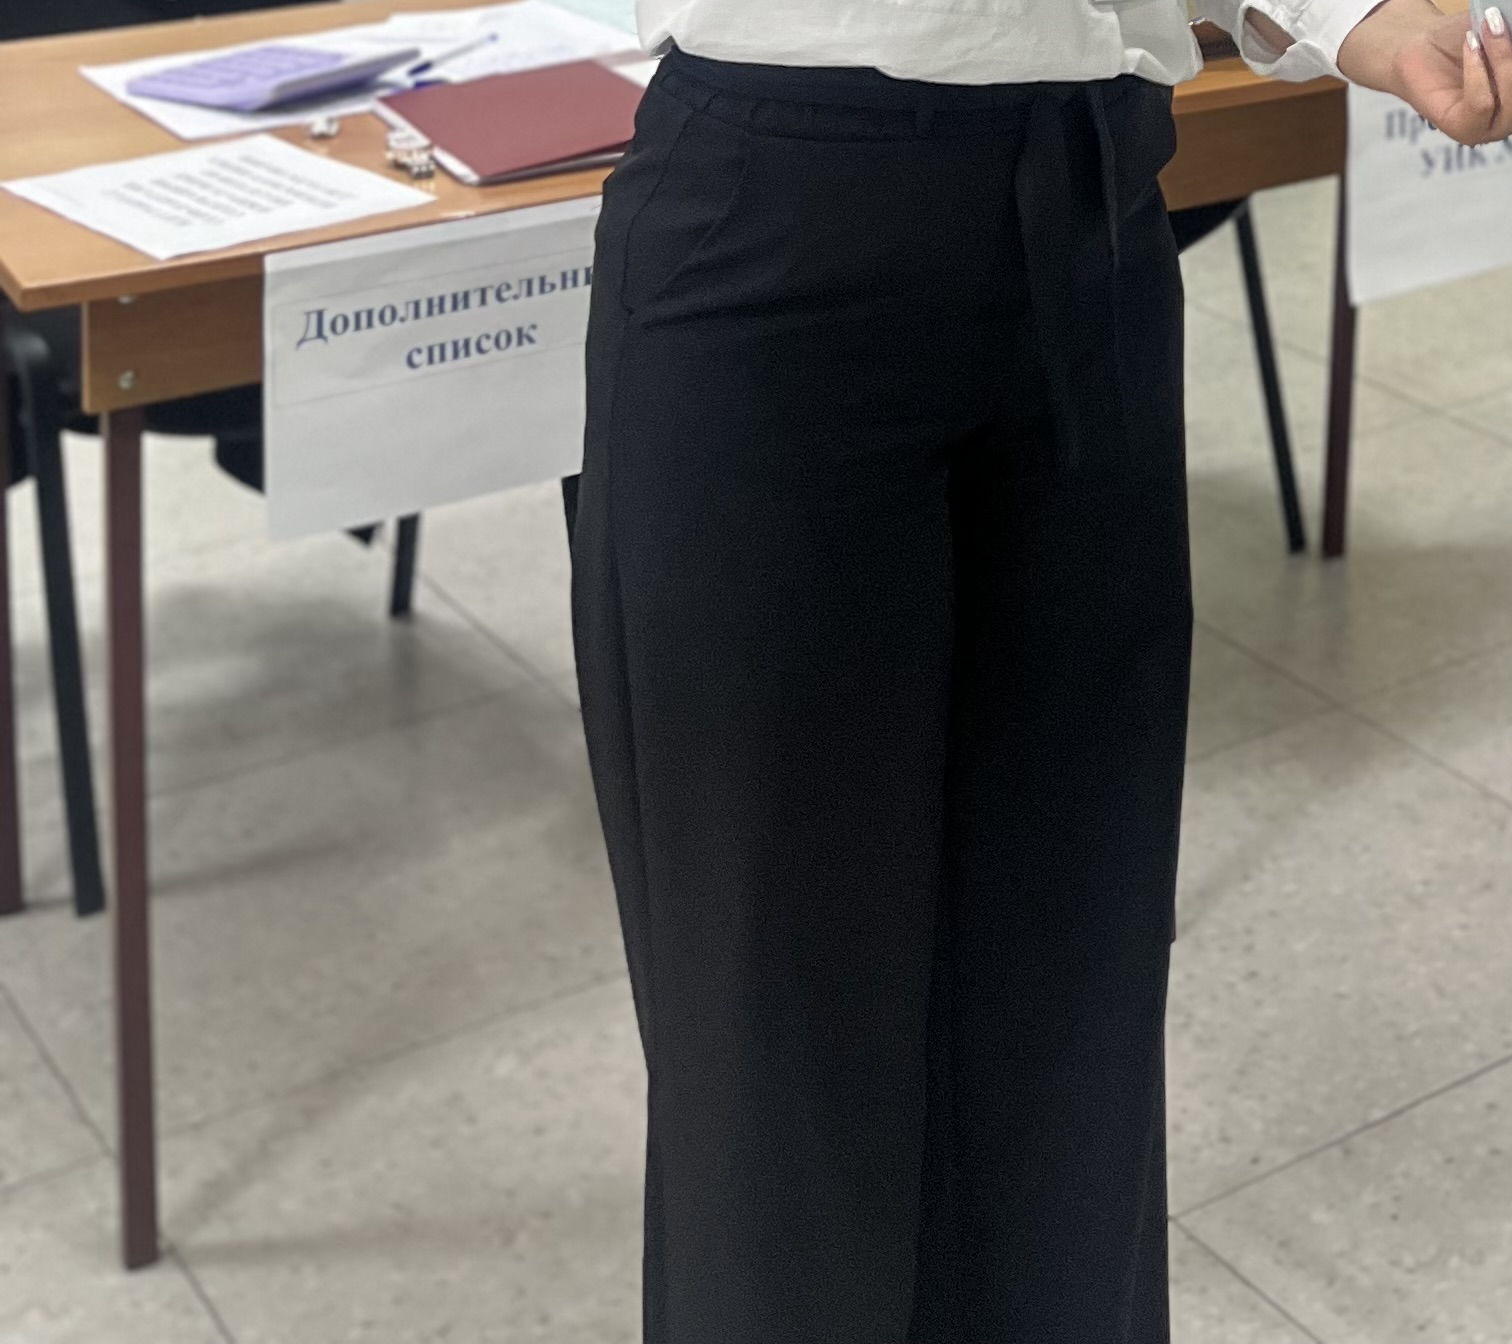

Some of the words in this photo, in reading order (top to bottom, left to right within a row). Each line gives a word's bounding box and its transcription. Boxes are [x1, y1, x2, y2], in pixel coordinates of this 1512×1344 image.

[1421, 143, 1488, 179] УИК
[297, 265, 593, 349] Дополнительн
[405, 323, 538, 369] список
